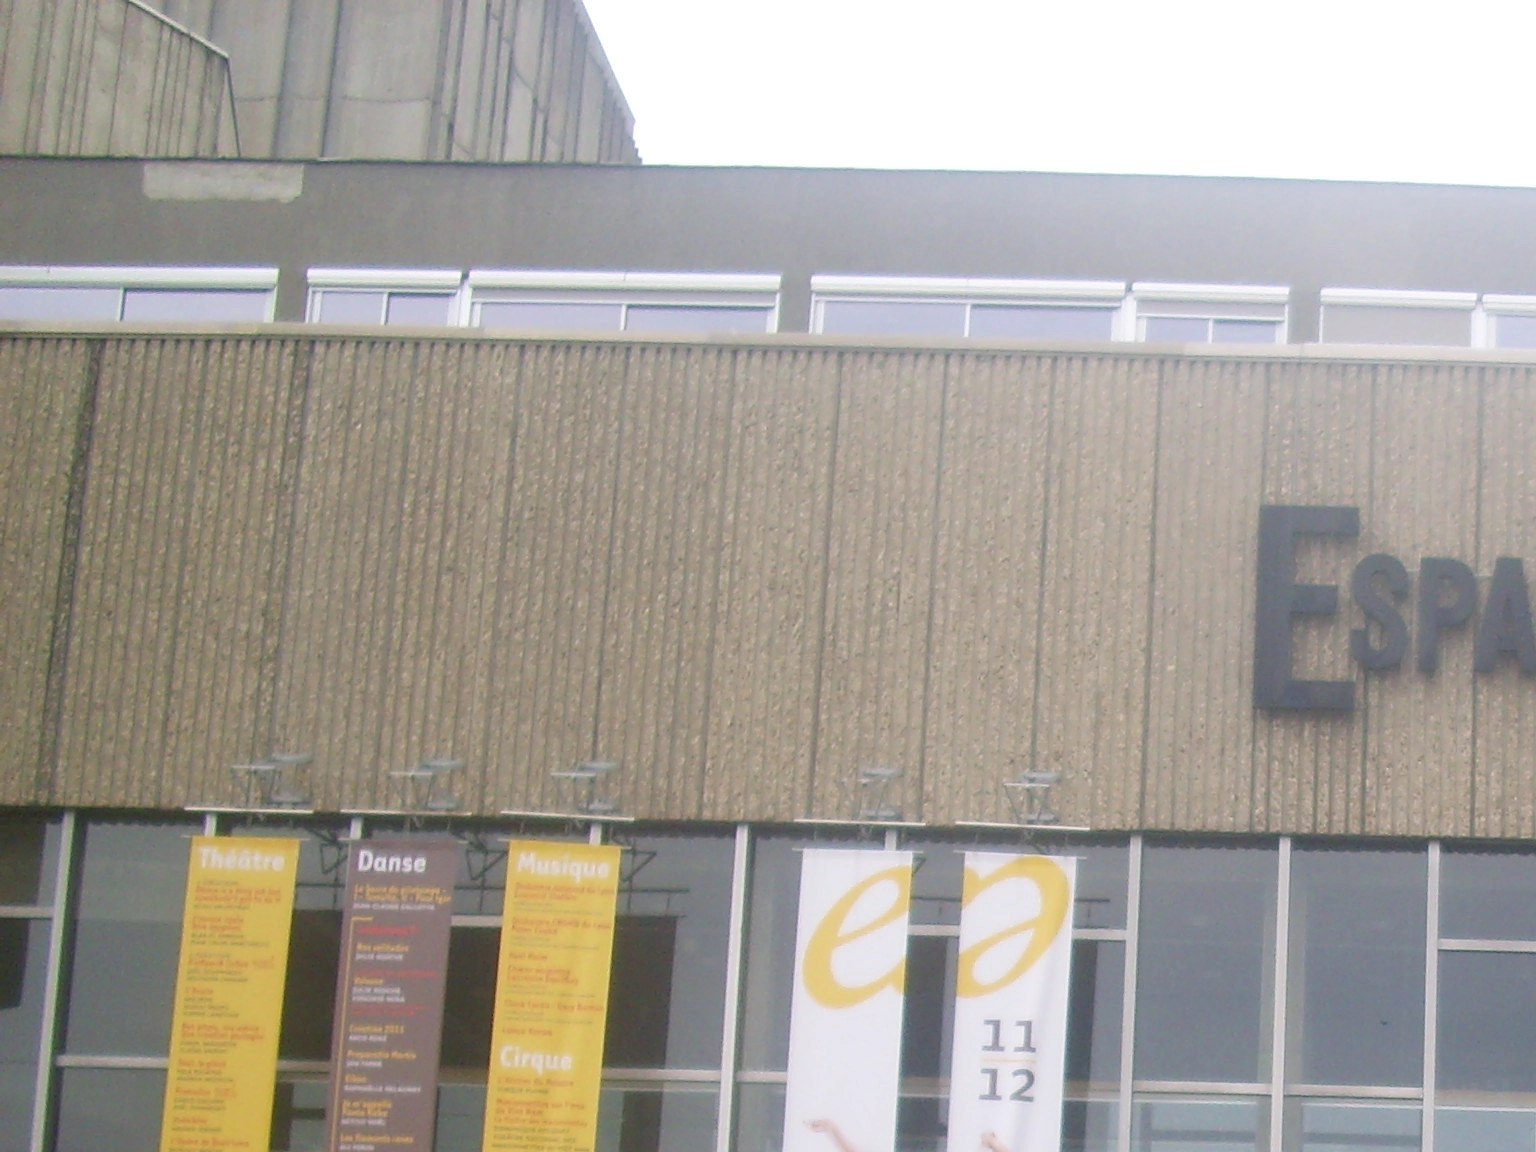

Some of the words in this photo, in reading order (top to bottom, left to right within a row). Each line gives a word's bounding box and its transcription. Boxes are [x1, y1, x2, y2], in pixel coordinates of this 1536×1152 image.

[199, 846, 286, 872] Théâtre
[358, 848, 427, 873] Danse
[518, 852, 610, 883] Musique
[981, 1019, 1037, 1053] 11
[500, 1044, 573, 1075] Cirque
[979, 1069, 1036, 1102] 12
